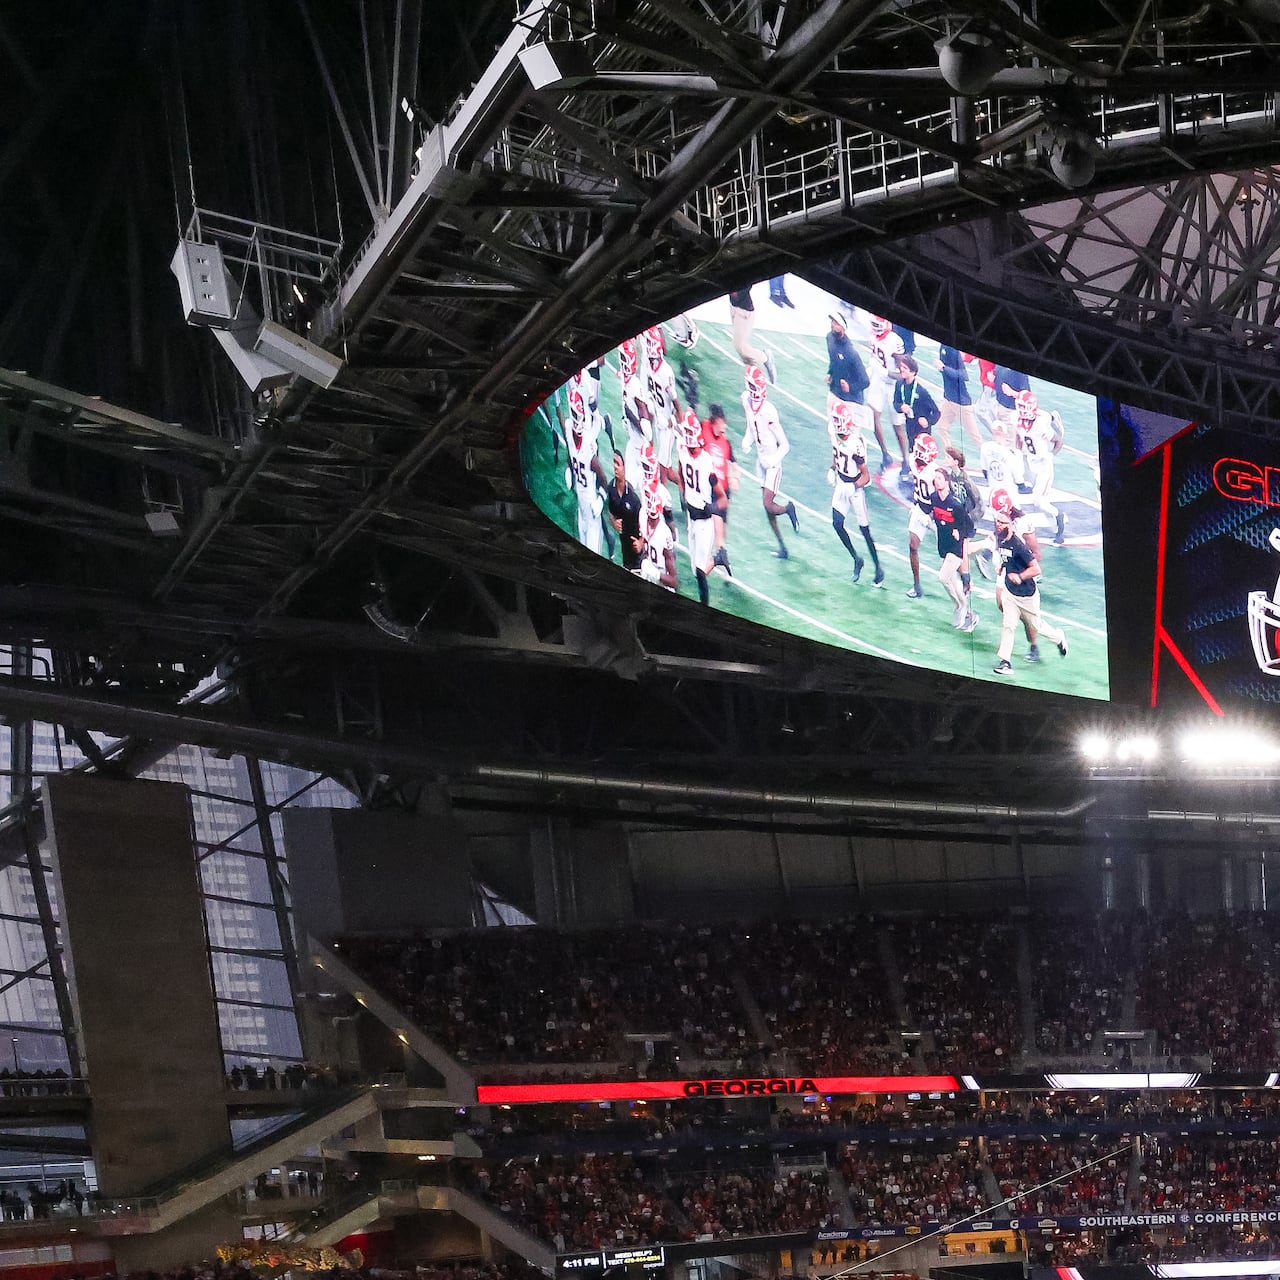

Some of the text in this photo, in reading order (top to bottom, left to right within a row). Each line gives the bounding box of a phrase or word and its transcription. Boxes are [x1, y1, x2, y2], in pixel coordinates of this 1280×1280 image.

[1025, 435, 1035, 455] 8
[684, 1080, 819, 1096] GEORGIA
[1079, 1214, 1175, 1228] SOUTHEASTERN
[562, 1257, 600, 1269] 4:11 PM
